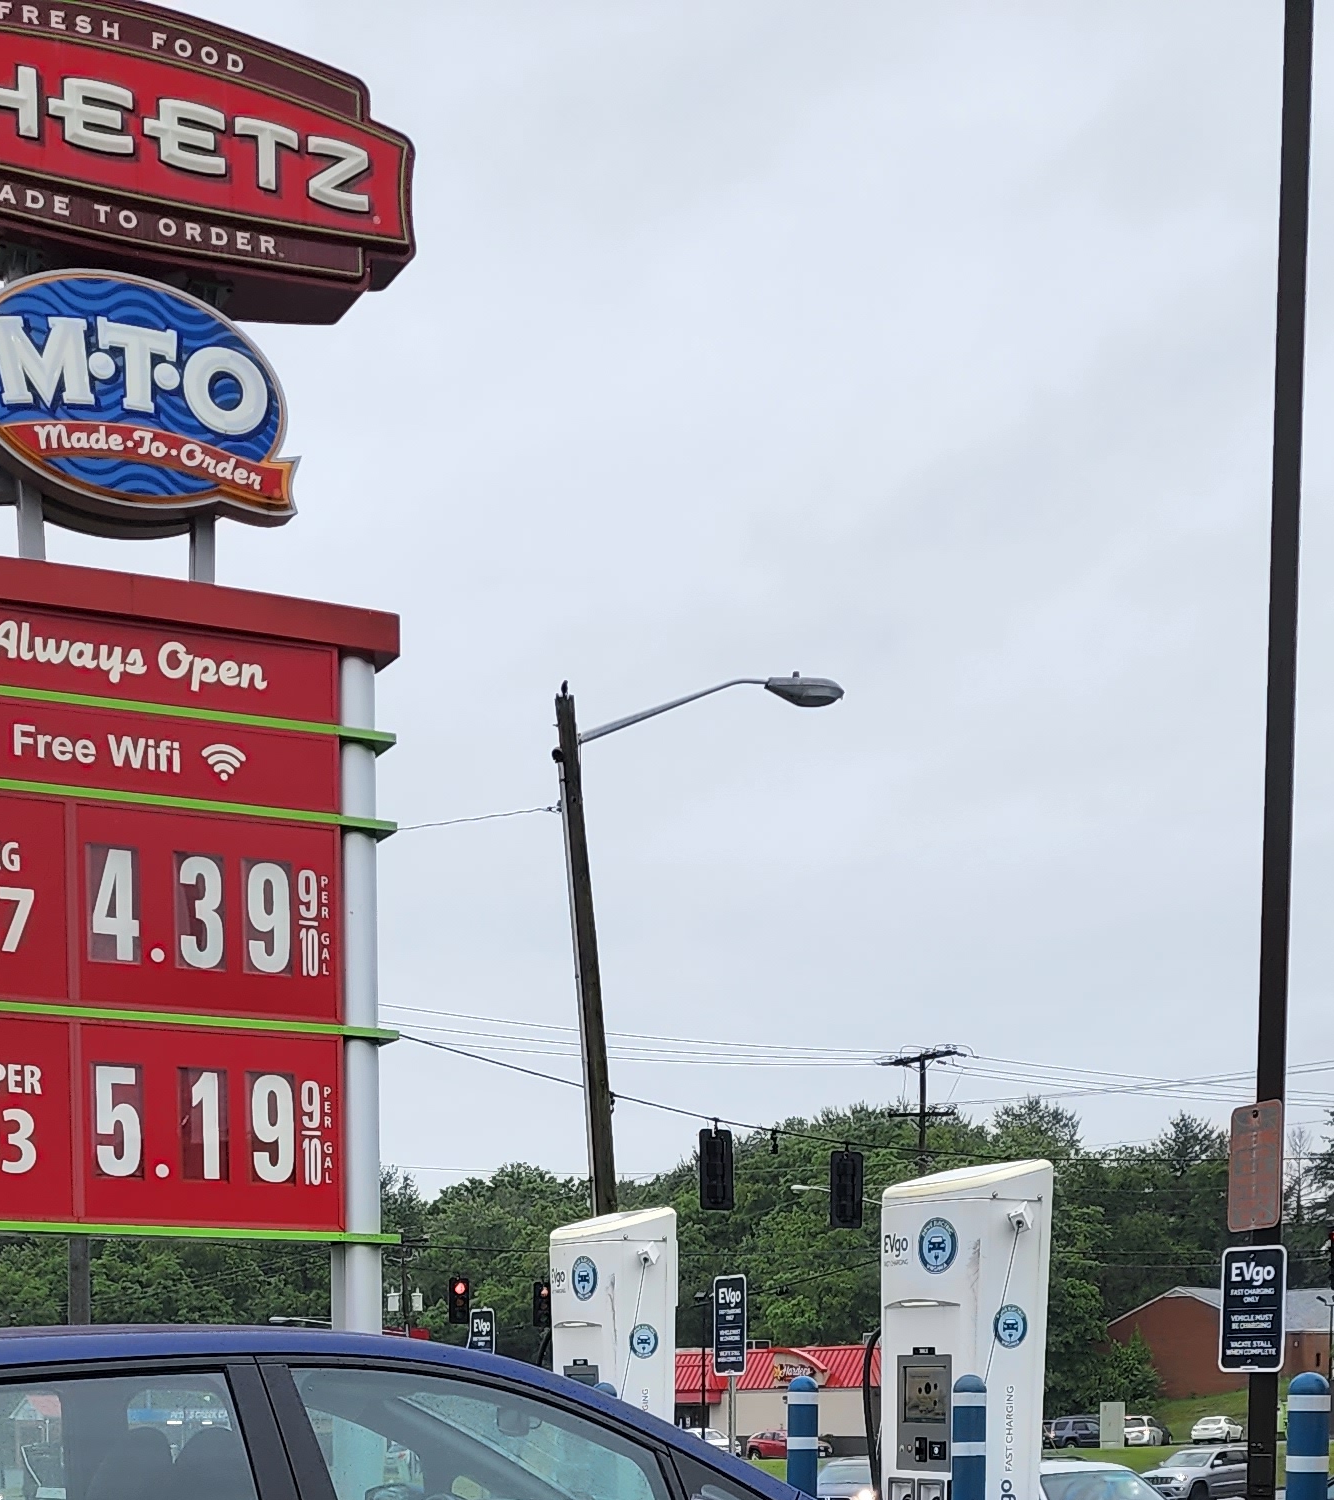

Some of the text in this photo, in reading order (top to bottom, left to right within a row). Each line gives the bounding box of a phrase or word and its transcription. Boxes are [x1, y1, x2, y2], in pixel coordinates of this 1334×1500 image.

[152, 32, 246, 74] FOOD
[94, 203, 138, 229] TO
[158, 217, 277, 256] ORDER
[158, 641, 268, 691] Open
[13, 724, 182, 774] Free Wifi
[92, 849, 291, 974] 4.39
[321, 876, 330, 919] PER
[321, 933, 330, 976] GAL
[95, 1066, 296, 1184] 5.19
[323, 1087, 332, 1128] PER
[323, 1142, 333, 1184] GAL
[883, 1233, 908, 1257] EVgo
[1230, 1262, 1275, 1285] EVgo
[718, 1287, 741, 1307] EVgo
[473, 1318, 491, 1336] EVgo
[1243, 1347, 1276, 1355] COMPLETE
[1005, 1385, 1015, 1473] FAST CHARGING
